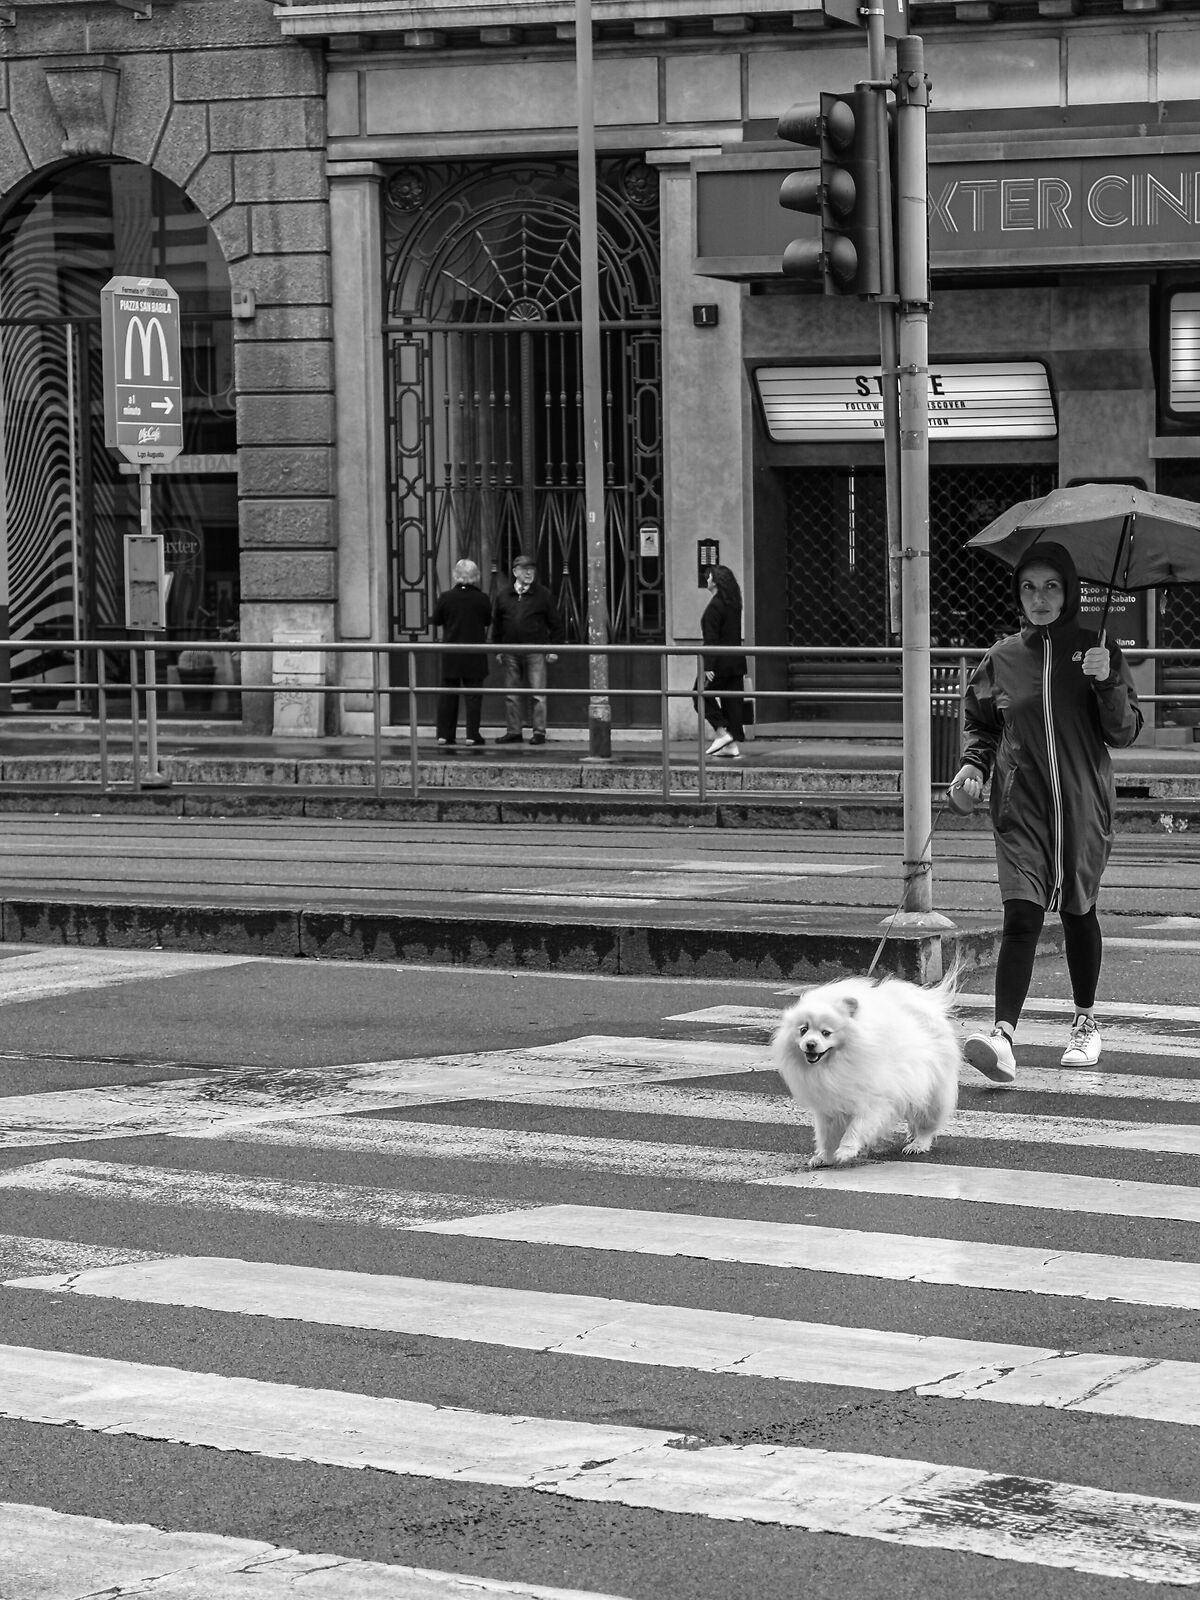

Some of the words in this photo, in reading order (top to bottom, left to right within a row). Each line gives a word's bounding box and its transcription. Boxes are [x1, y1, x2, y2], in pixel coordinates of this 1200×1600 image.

[928, 178, 1073, 233] XTER
[120, 300, 139, 312] PIAZZA
[140, 301, 151, 312] SAN
[151, 302, 172, 314] BABILA
[700, 307, 707, 322] 1
[855, 374, 945, 397] STE
[845, 402, 880, 411] FOLLOW
[873, 419, 884, 427] OU
[164, 540, 198, 554] axter
[1080, 587, 1100, 595] 15:00
[1111, 595, 1136, 603] Sabato
